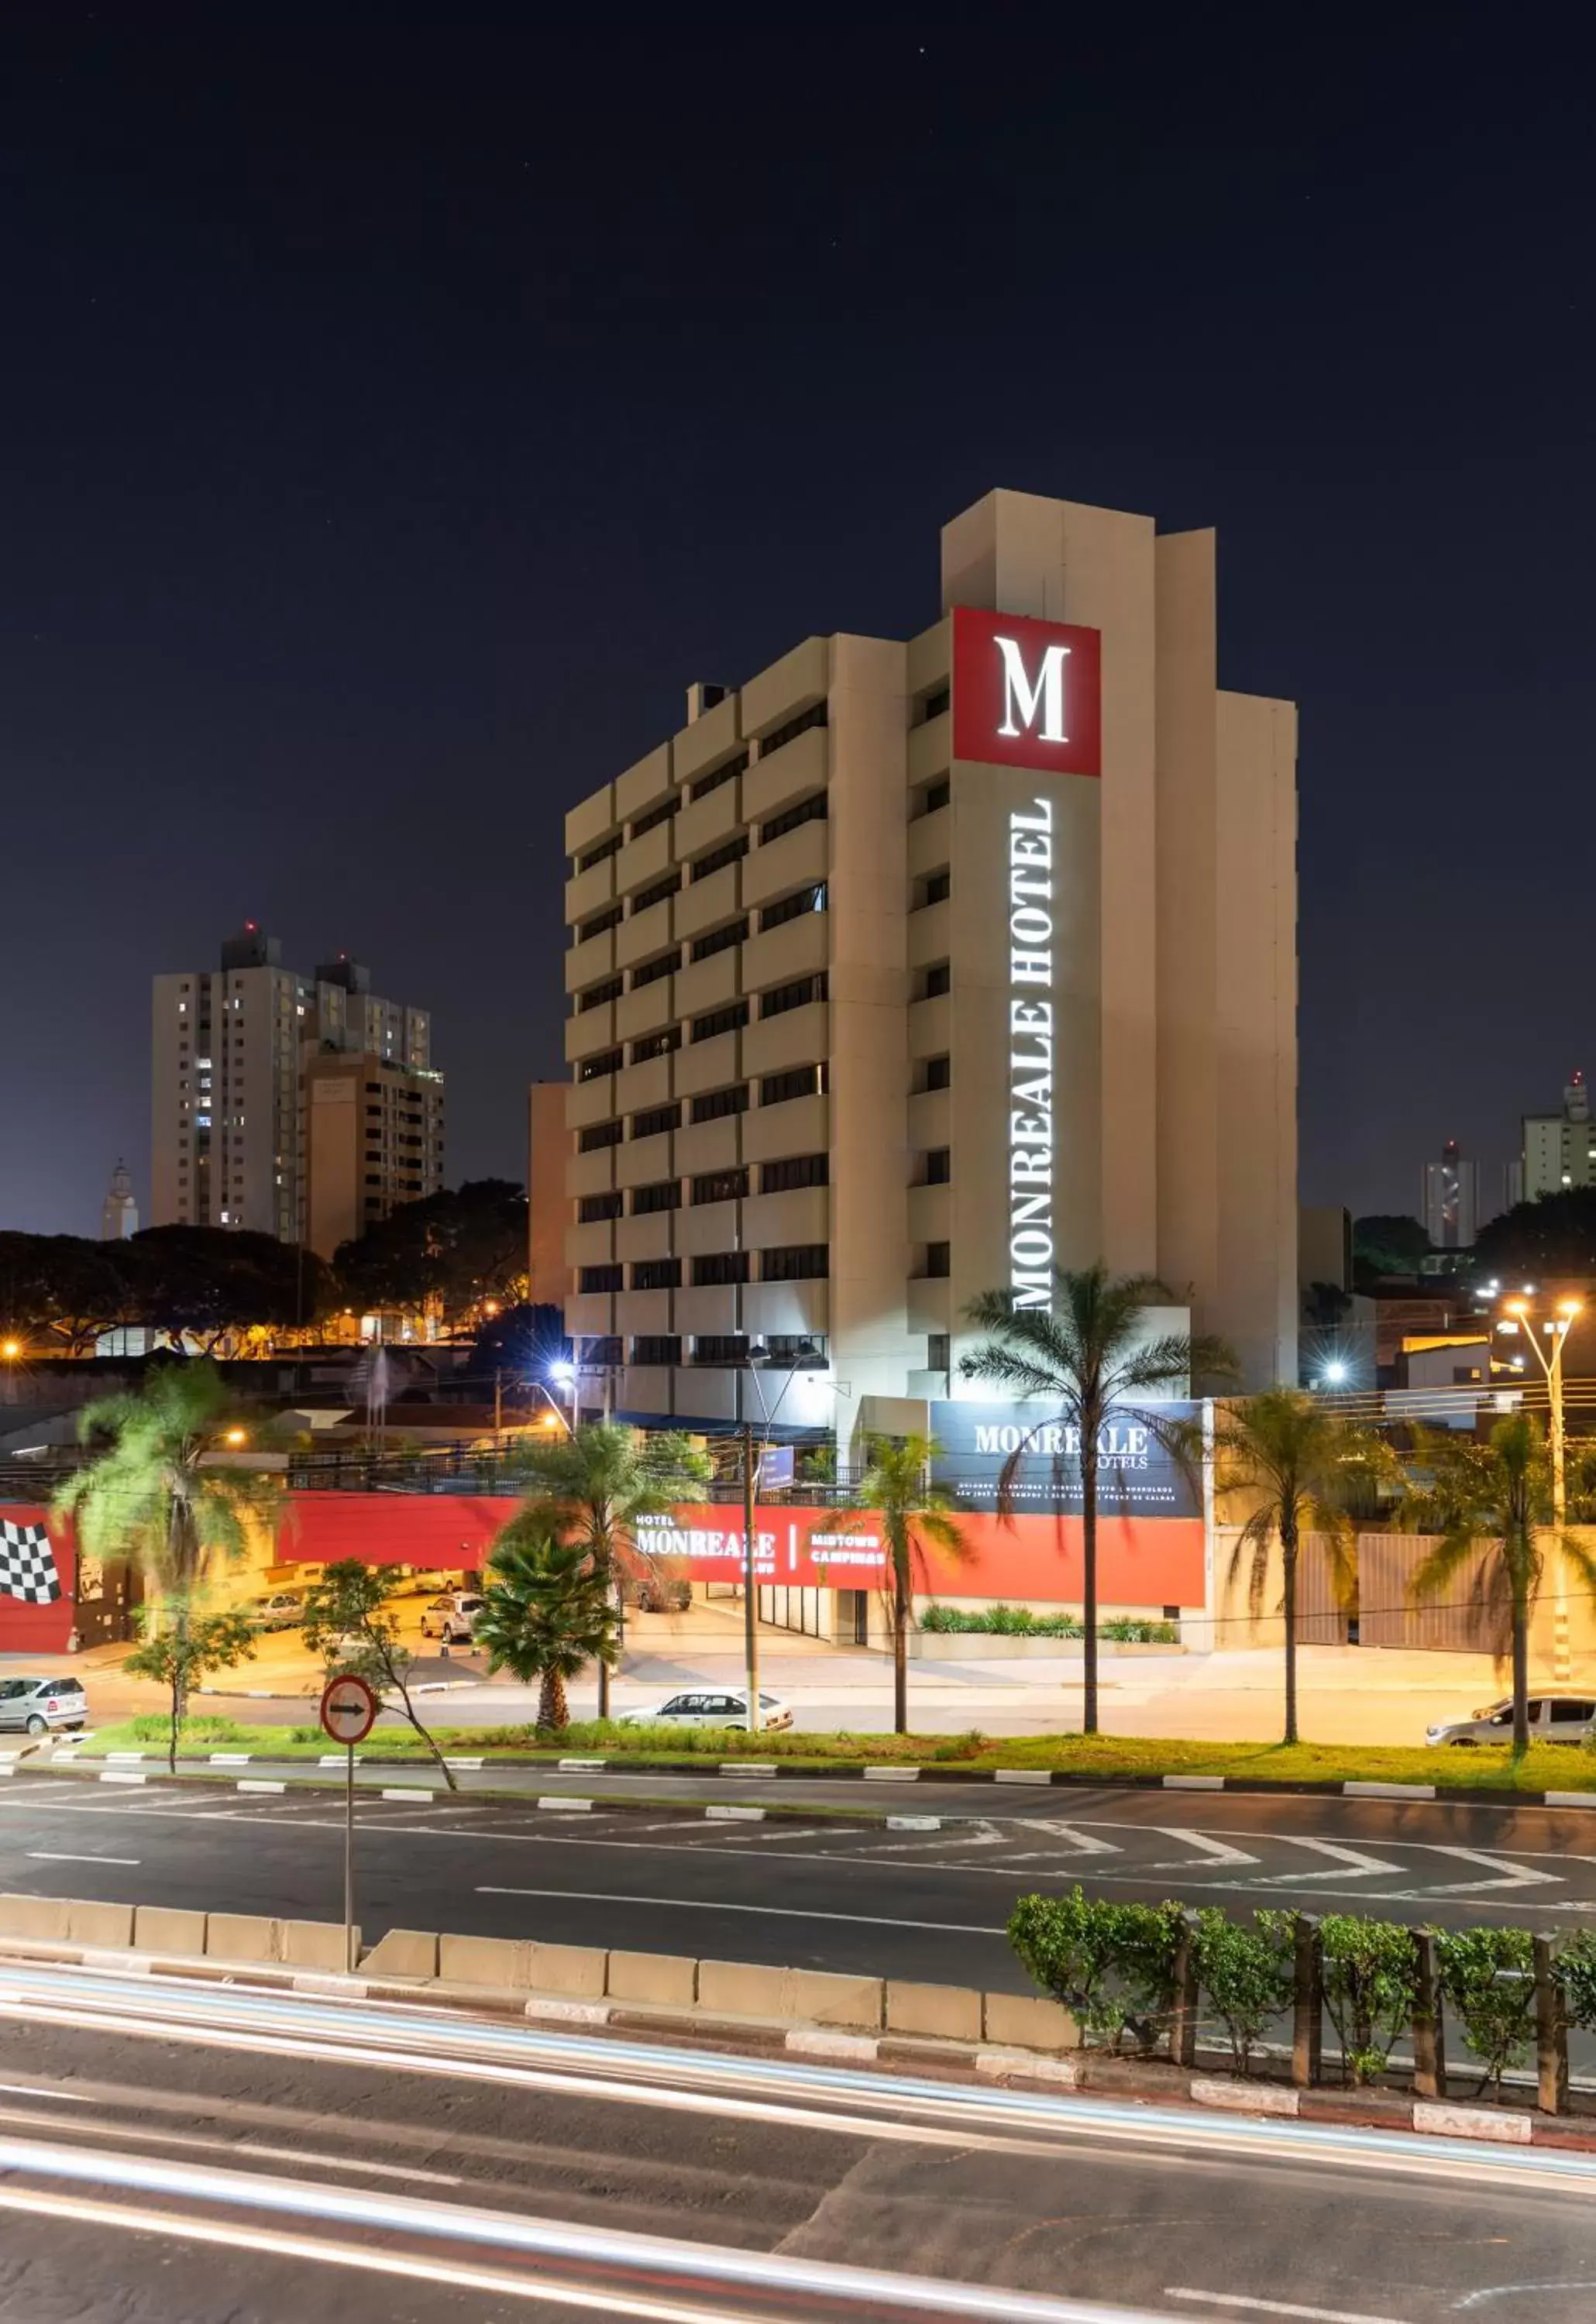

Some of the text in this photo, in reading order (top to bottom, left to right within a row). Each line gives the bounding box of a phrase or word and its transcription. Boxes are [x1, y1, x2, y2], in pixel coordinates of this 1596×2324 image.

[992, 635, 1071, 743] M
[1010, 797, 1053, 1315] MONREALE HOTEL
[1097, 1456, 1148, 1470] OTELS
[636, 1514, 675, 1527] HOTEL
[810, 1534, 879, 1548] MIDTOWN
[810, 1550, 885, 1565] CAMPINAS
